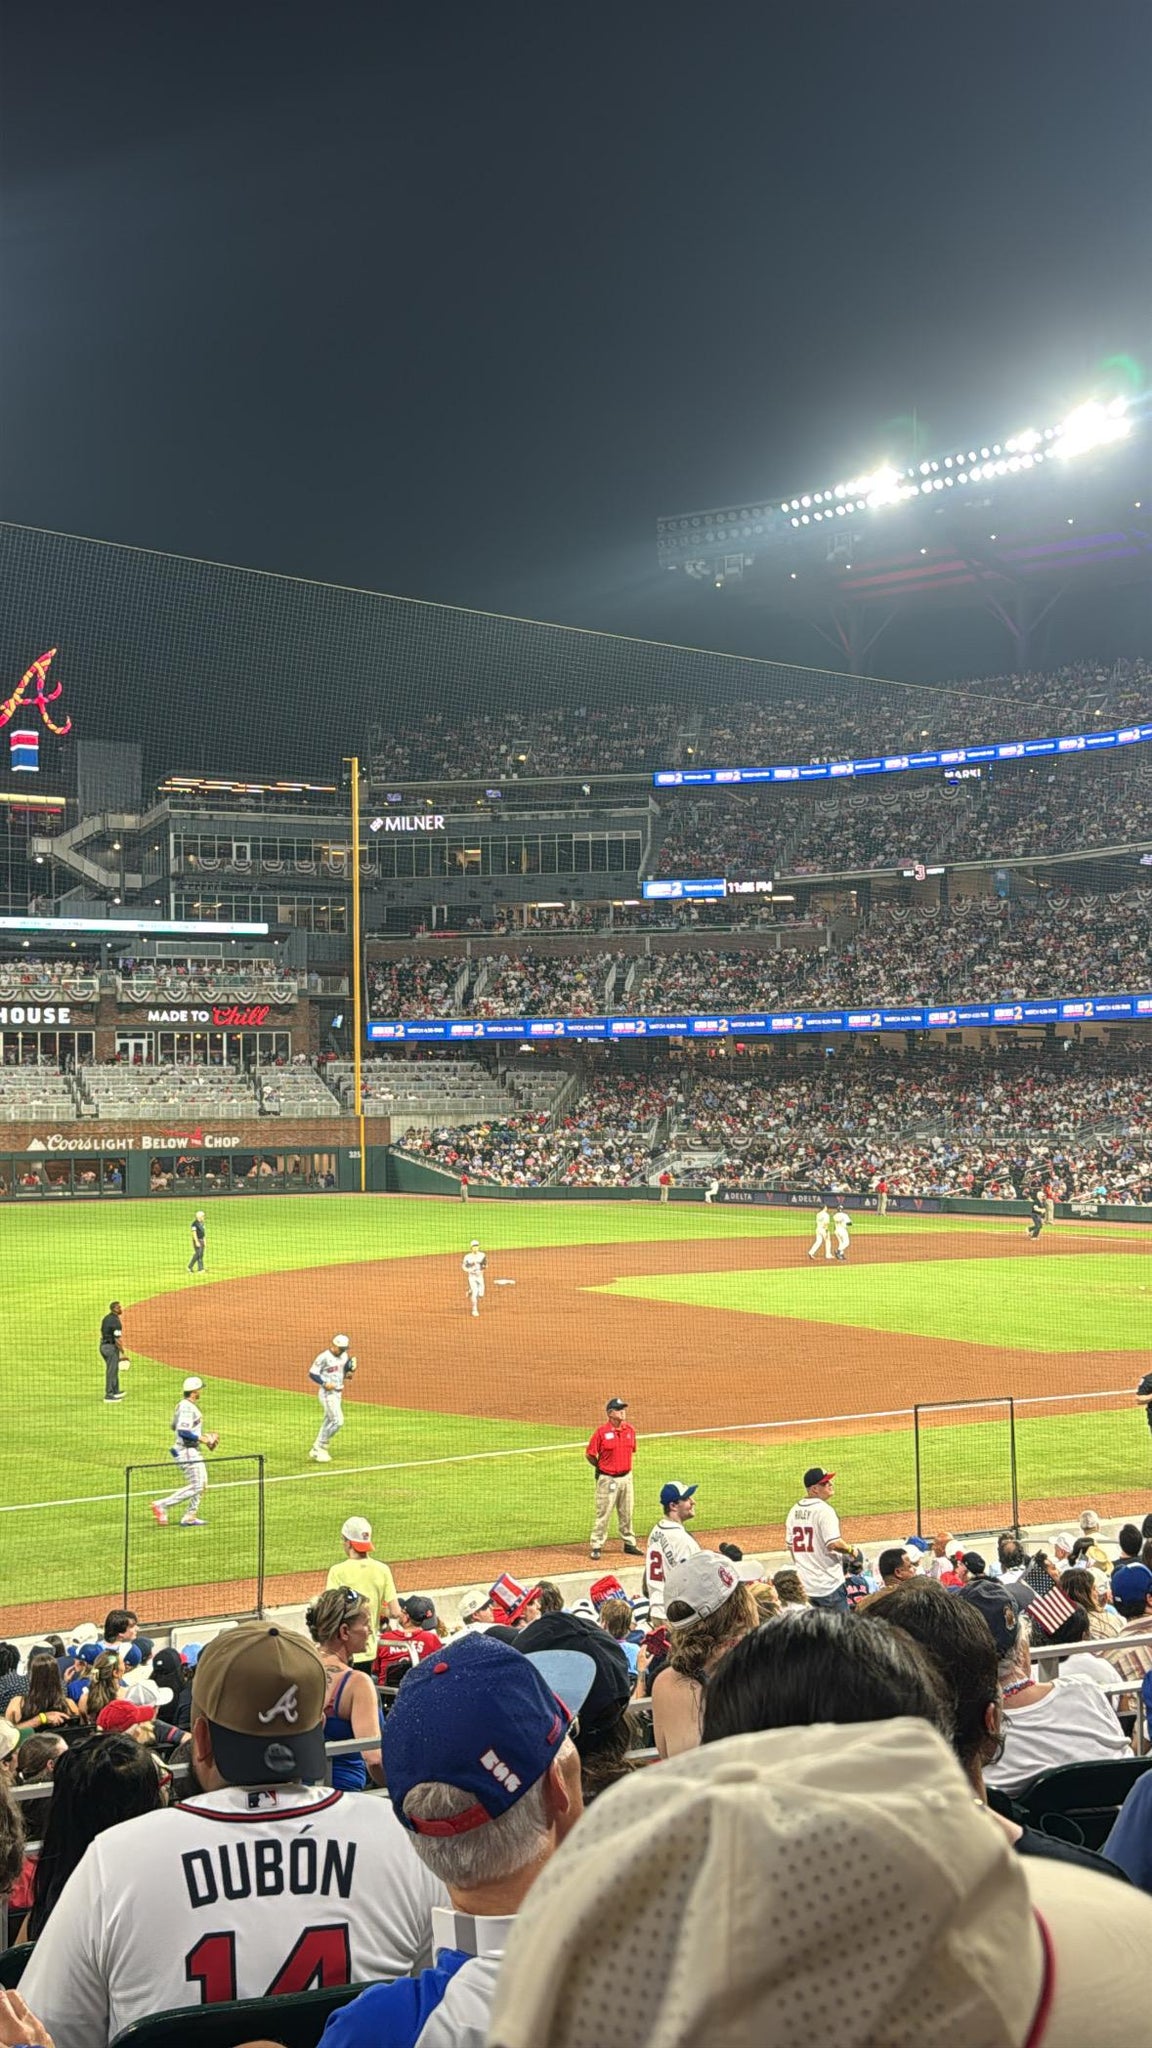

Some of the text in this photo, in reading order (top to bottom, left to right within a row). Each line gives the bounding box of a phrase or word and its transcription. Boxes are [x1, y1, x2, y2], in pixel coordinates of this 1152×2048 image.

[385, 815, 445, 831] MILNER
[0, 1007, 70, 1024] HOUSE
[148, 1005, 270, 1026] MADE TO Chill
[47, 1133, 92, 1150] Coors
[94, 1138, 134, 1149] LIGHT
[142, 1135, 188, 1149] BELOW
[204, 1135, 240, 1148] CHOP
[730, 1192, 752, 1201] DELTA
[797, 1195, 822, 1203] DELTA
[872, 1198, 898, 1206] DTA
[793, 1526, 814, 1552] 27
[258, 1683, 299, 1724] A
[181, 1823, 357, 1909] DUBÓN
[185, 1922, 352, 2004] 14
